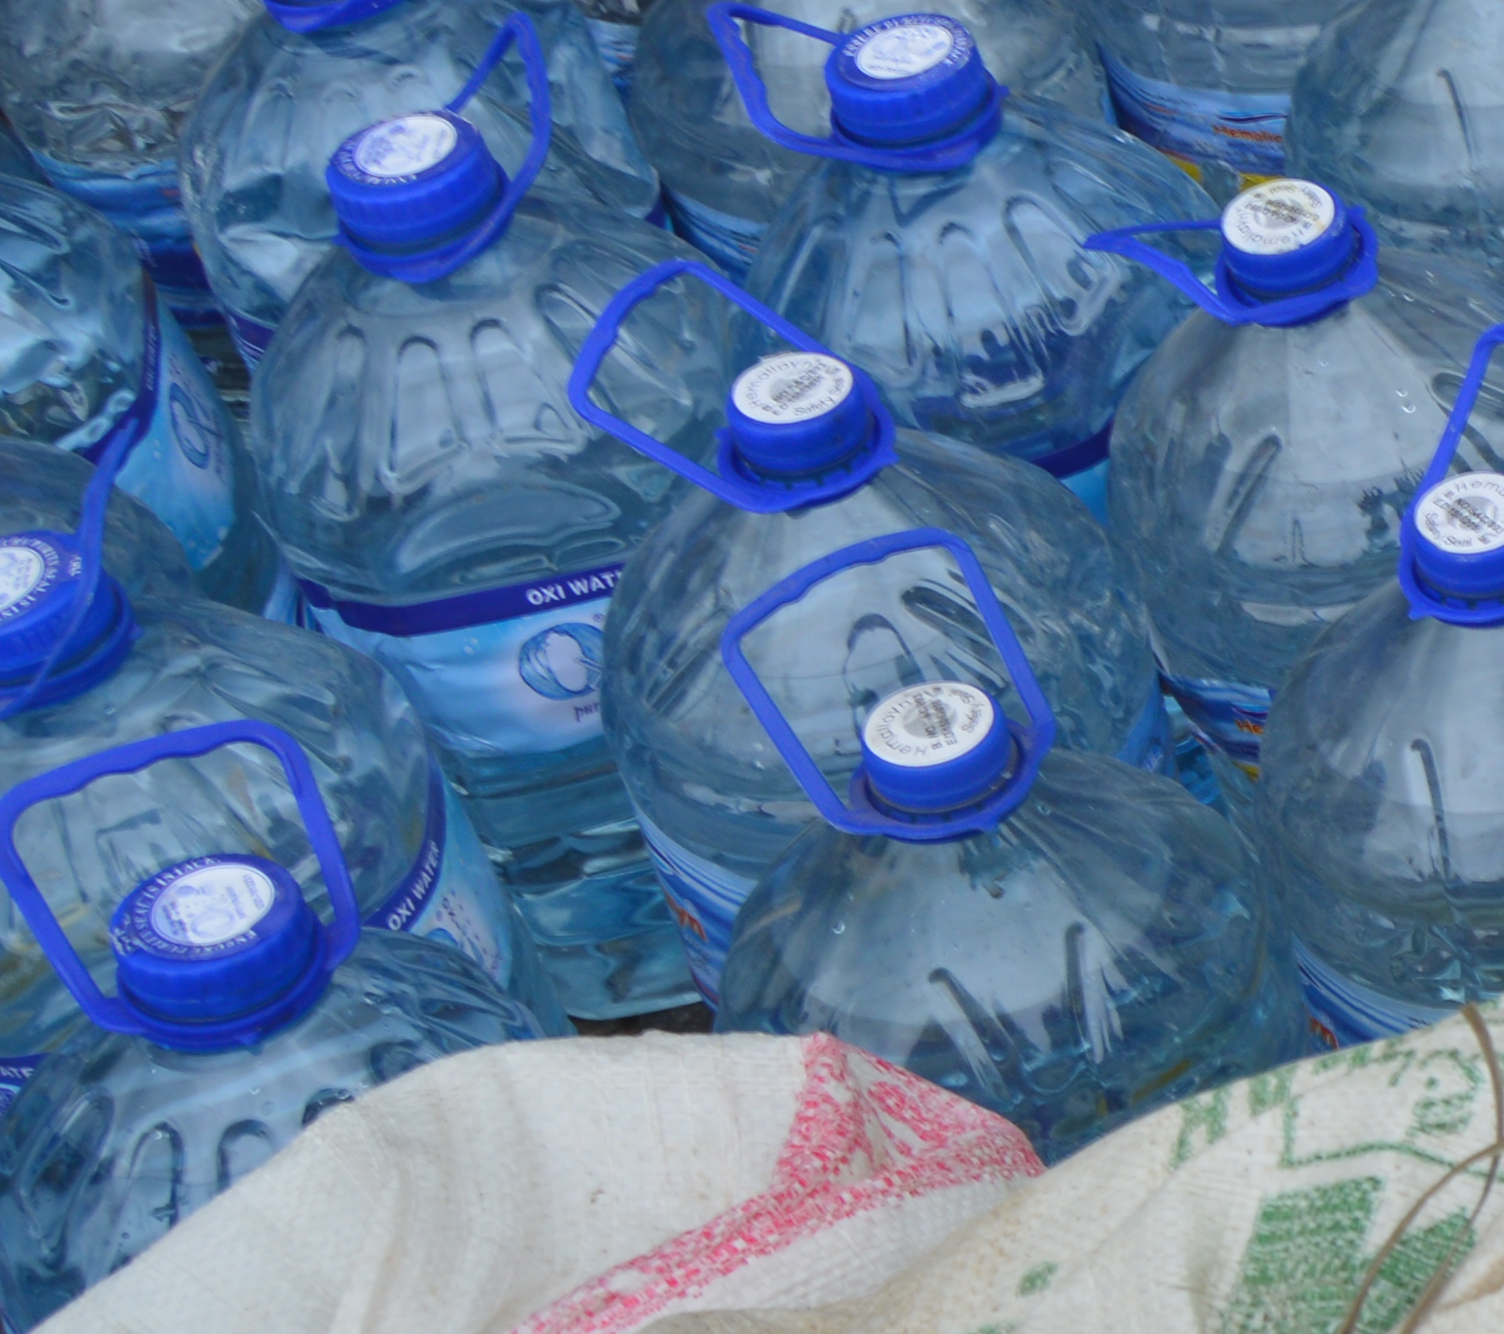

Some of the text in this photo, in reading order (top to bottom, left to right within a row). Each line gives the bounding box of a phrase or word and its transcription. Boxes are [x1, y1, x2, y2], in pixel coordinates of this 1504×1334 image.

[526, 582, 567, 606] OXI
[387, 839, 441, 932] OXI WATER
